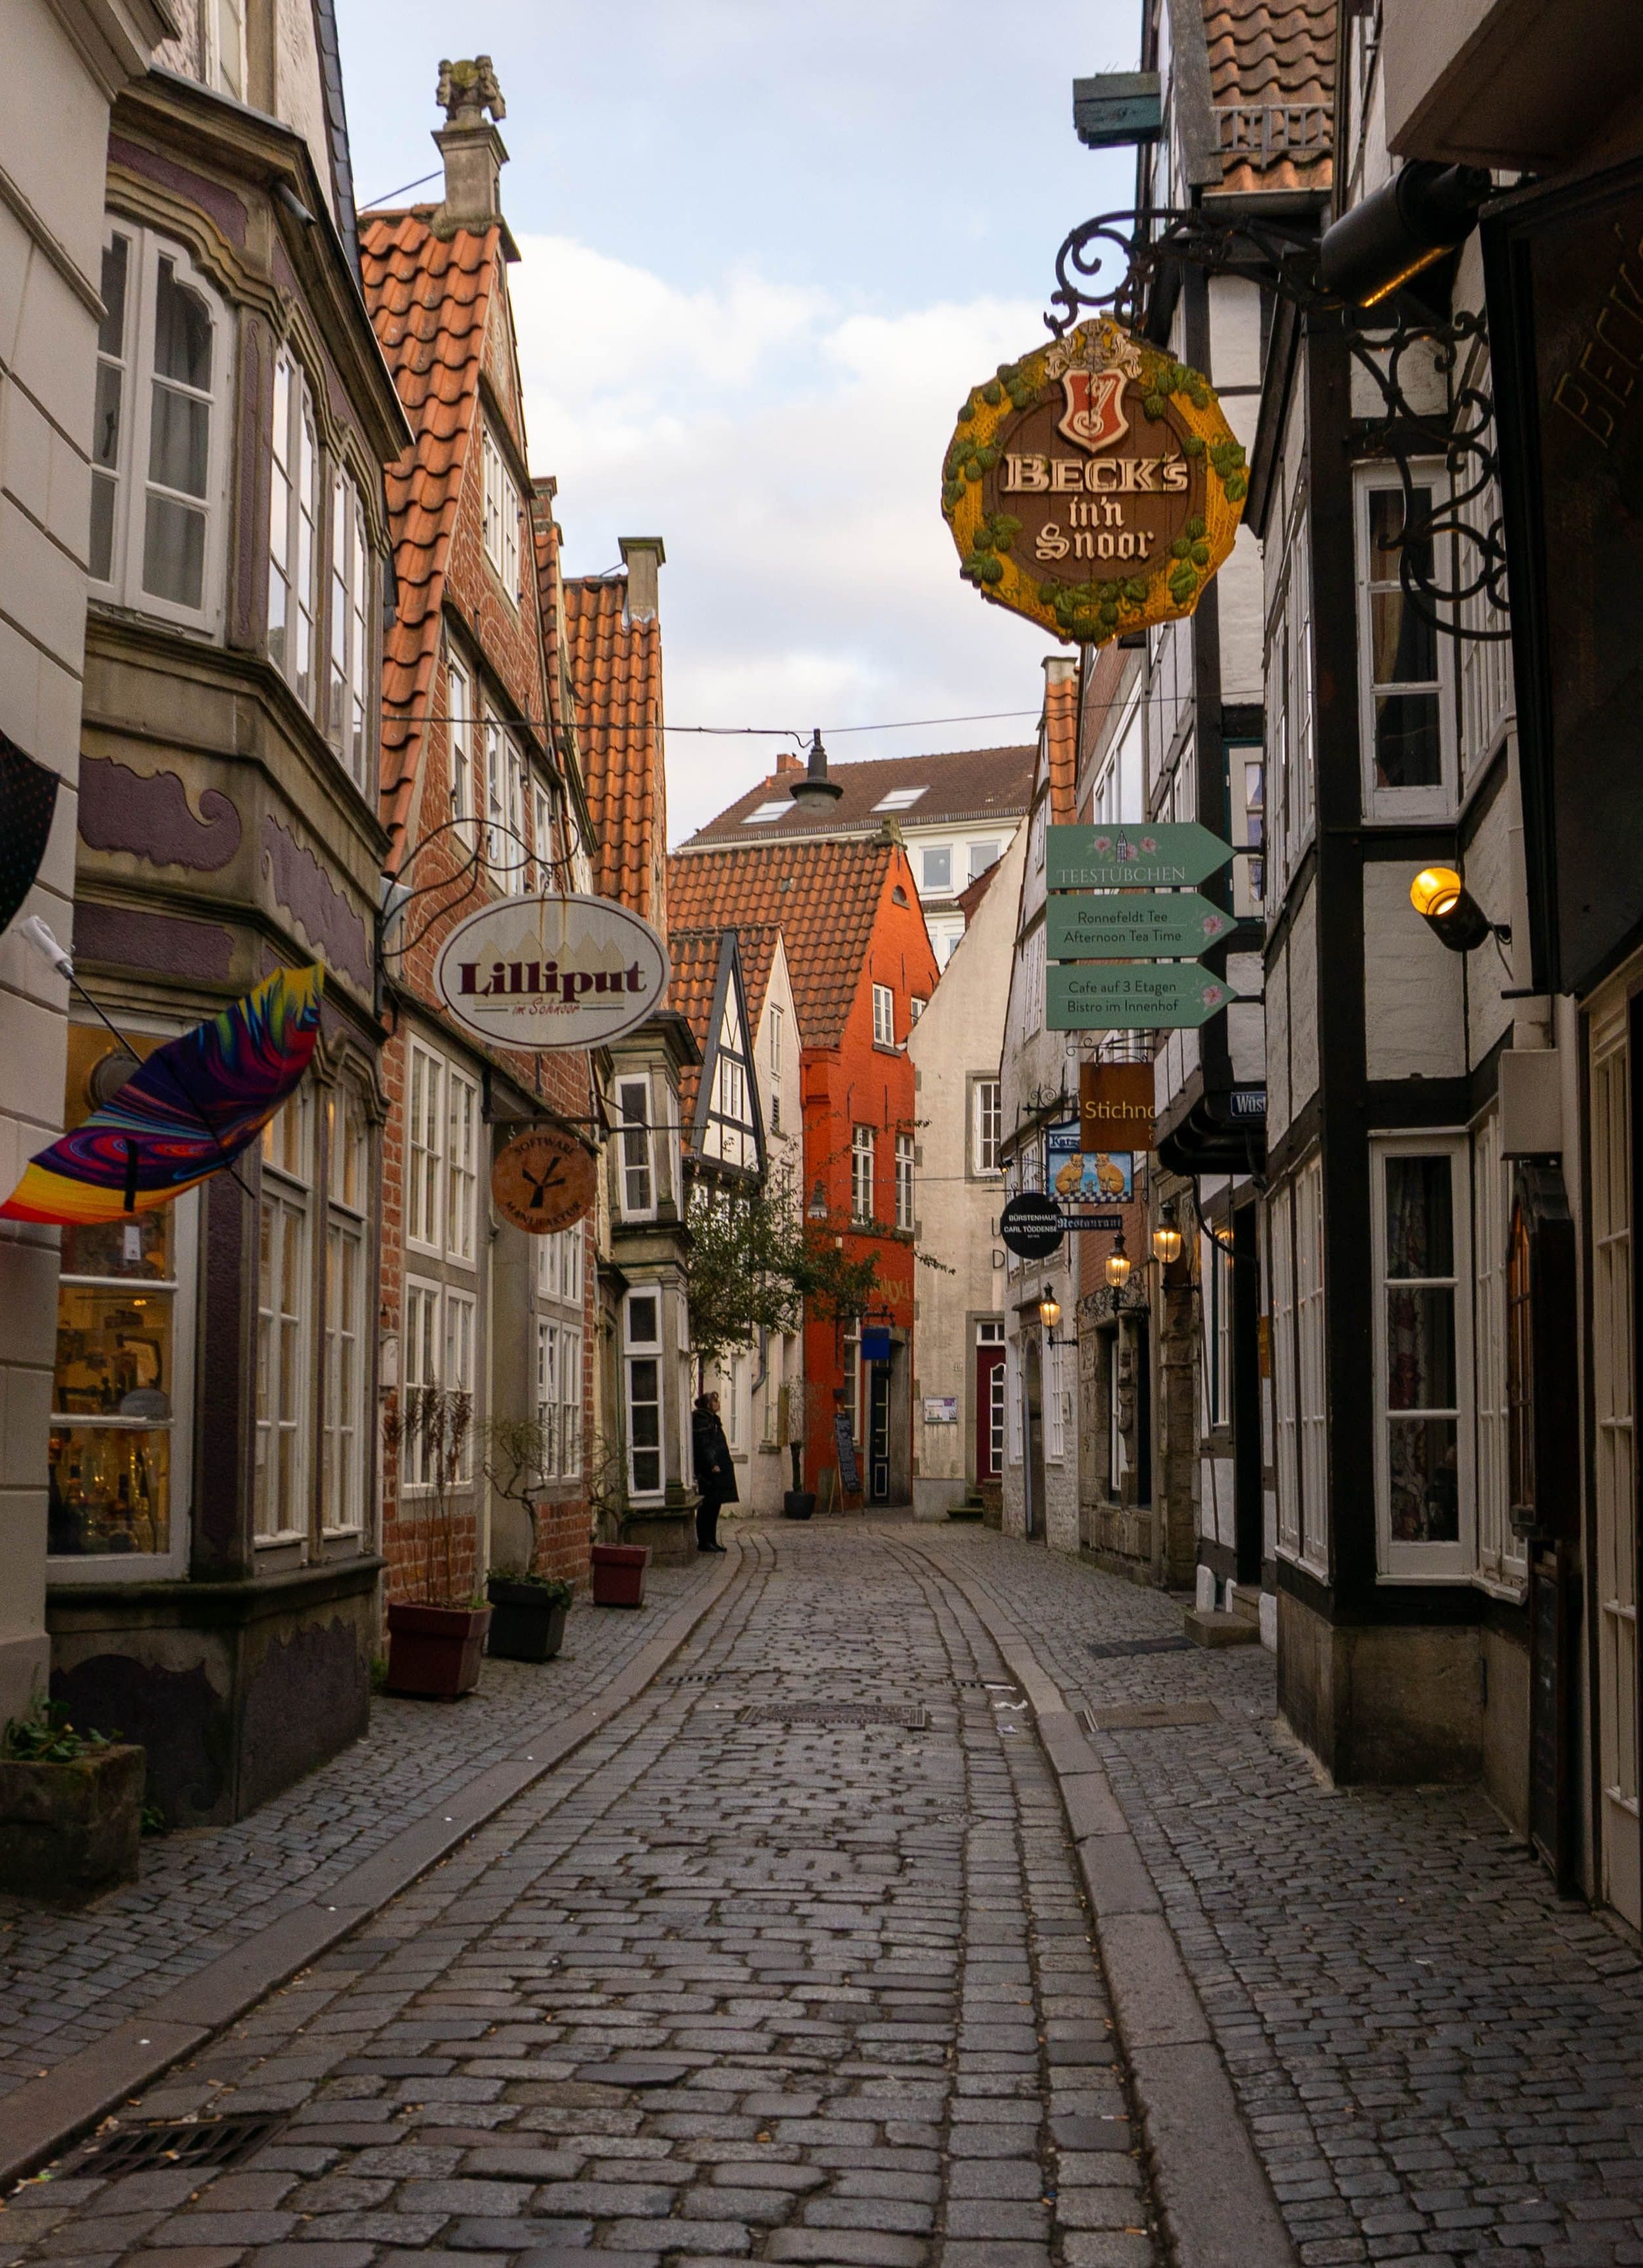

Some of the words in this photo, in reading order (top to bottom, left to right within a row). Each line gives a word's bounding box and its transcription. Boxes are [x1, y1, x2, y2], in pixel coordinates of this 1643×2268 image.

[1035, 523, 1154, 561] Snoor
[1056, 866, 1186, 884] TEESTÜBCHEN
[1079, 912, 1143, 925] Ronnefeldt
[1147, 910, 1168, 923] Tee
[1064, 931, 1126, 943] Afternoon
[1129, 930, 1149, 942] Tea
[1152, 929, 1182, 942] Time
[458, 961, 648, 1003] Lilliput
[1068, 980, 1097, 994] Cafe
[1100, 980, 1121, 993] auf
[1123, 981, 1131, 992] 3
[1135, 979, 1177, 997] Etagen
[1067, 1001, 1103, 1013] Bistro
[1105, 1001, 1121, 1012] im
[1125, 999, 1179, 1012] Innenhof
[1057, 1218, 1121, 1229] Restaurant
